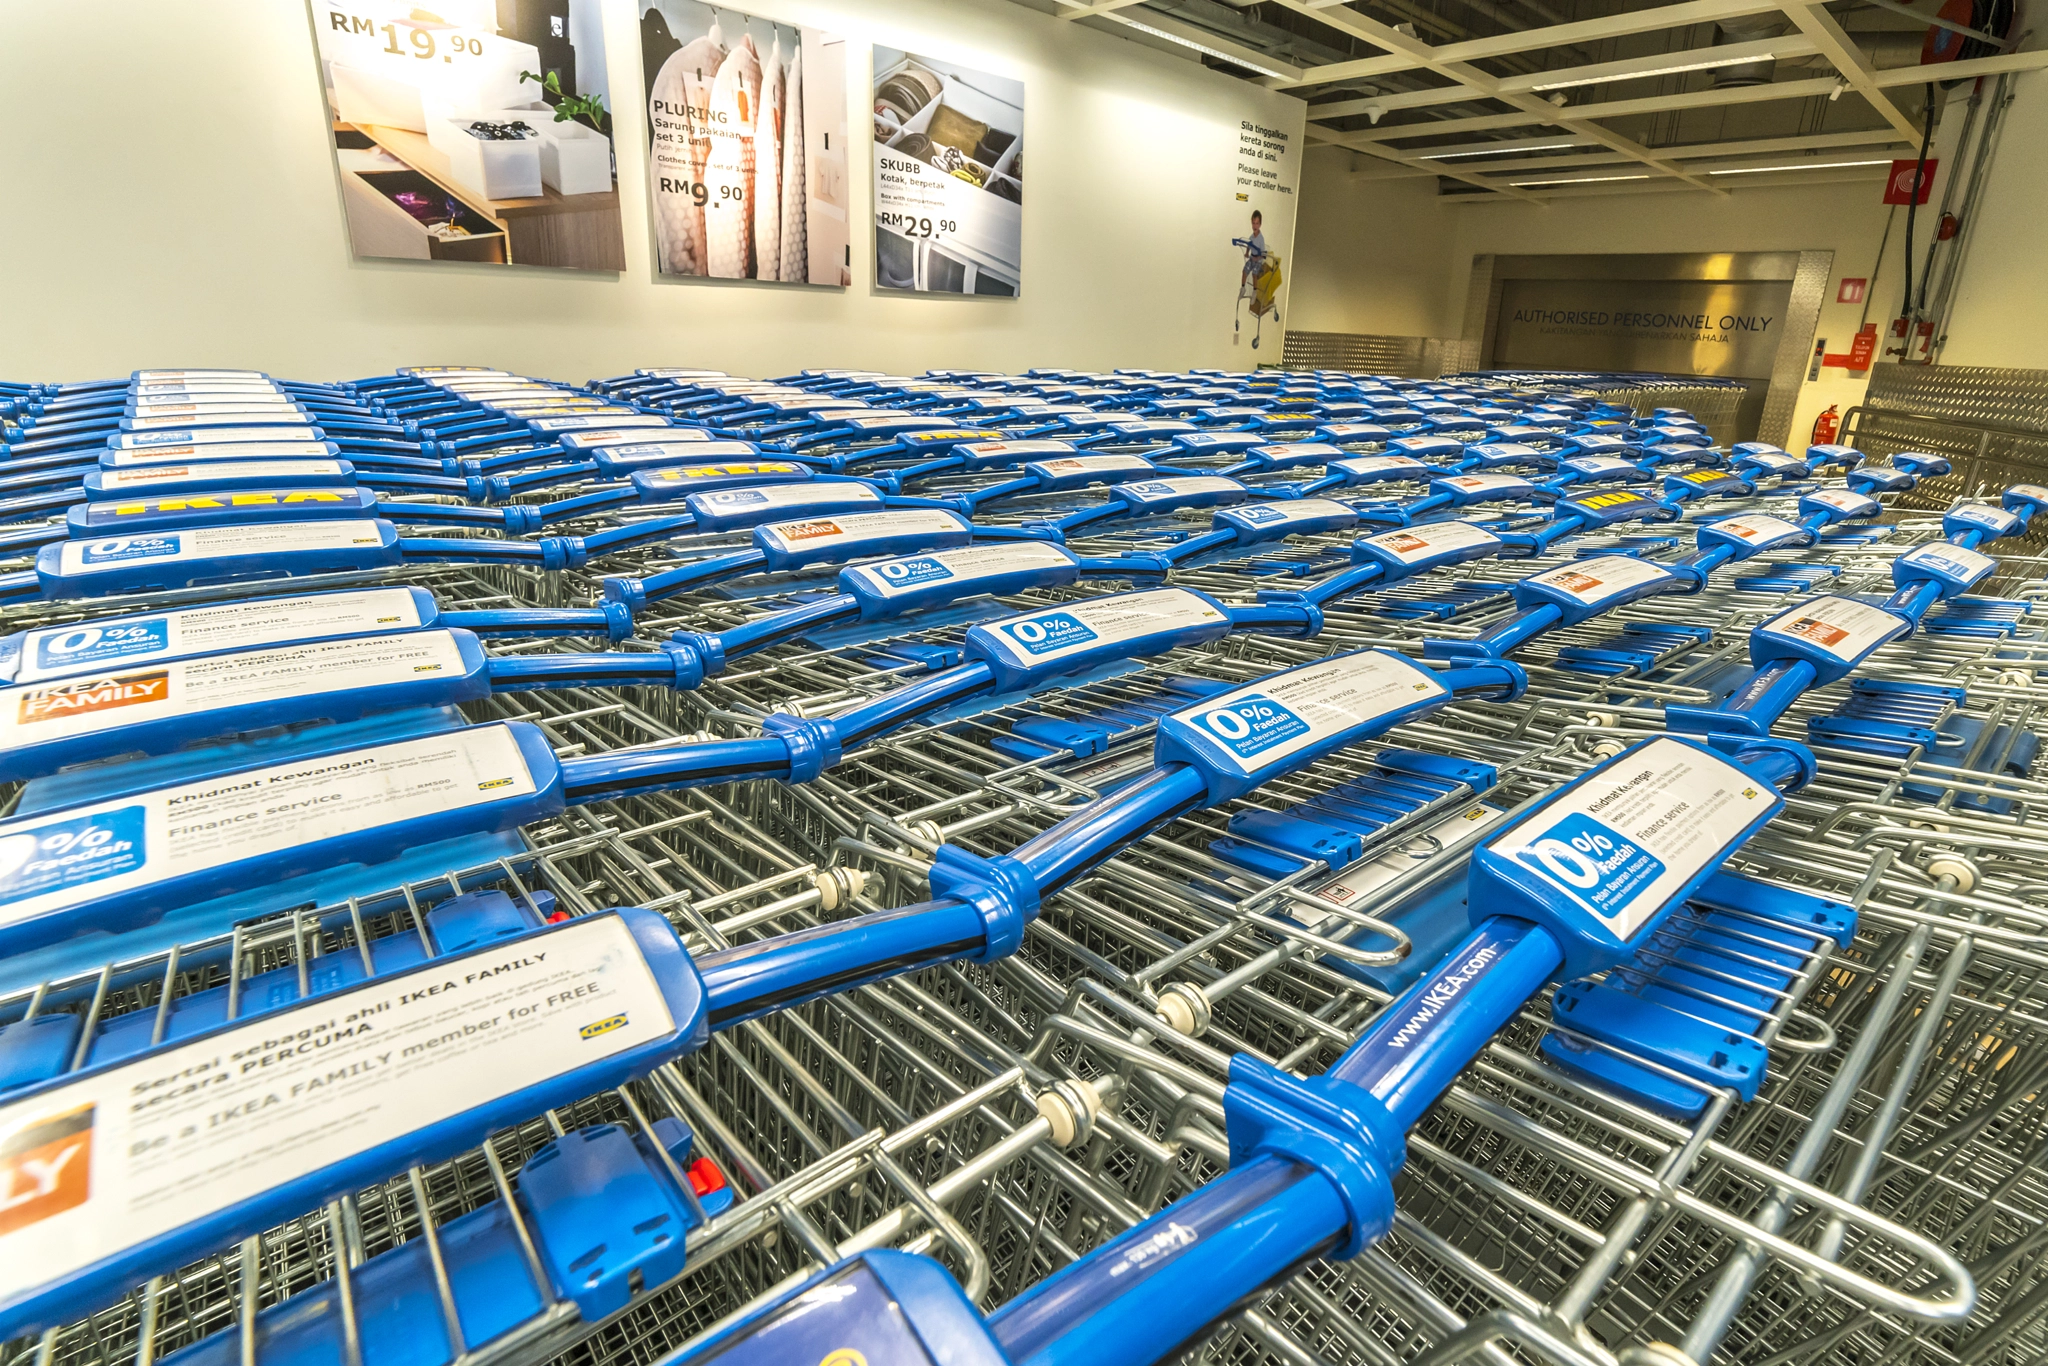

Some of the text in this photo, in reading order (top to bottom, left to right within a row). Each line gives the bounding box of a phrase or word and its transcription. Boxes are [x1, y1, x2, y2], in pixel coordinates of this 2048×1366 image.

[330, 11, 483, 63] RM19.90
[654, 100, 728, 124] PLURING
[655, 118, 695, 134] Sarung
[1241, 120, 1289, 141] Sila tinggalkan
[656, 132, 674, 142] set
[678, 134, 684, 144] 3
[1240, 133, 1285, 154] kereta sorong
[657, 154, 687, 165] Clothes
[1239, 145, 1278, 162] anda di sini.
[880, 158, 921, 174] SKUBB
[1238, 163, 1278, 180] Please leave
[660, 177, 743, 209] RM9.90
[880, 173, 945, 190] Kotak, berpetak
[1236, 176, 1293, 194] your stroller here.
[881, 212, 957, 239] RM29.90
[1513, 309, 1773, 332] AUTHORISED PERSONNEL ONLY
[1689, 332, 1729, 343] SAHAJA
[659, 463, 793, 480] IKEA
[116, 491, 344, 516] IKEA
[1576, 491, 1645, 510] IKEA
[784, 525, 836, 539] FAMILY
[91, 538, 165, 555] 0%
[882, 561, 932, 578] 0%
[911, 566, 943, 576] Faedah
[180, 607, 240, 619] Khidmat
[243, 600, 313, 611] Kewangan
[1092, 614, 1123, 627] Finance
[181, 617, 290, 635] Finance service
[1013, 619, 1071, 643] 0%
[1049, 625, 1084, 638] Faedah
[47, 627, 148, 654] 0%
[95, 634, 160, 649] Faedah
[320, 644, 353, 652] IKEA
[356, 638, 405, 648] FAMILY
[185, 654, 307, 675] secara PERCUMA
[185, 680, 204, 688] Be
[222, 672, 259, 682] IKEA
[262, 664, 315, 676] FAMILY
[319, 656, 373, 669] member
[376, 654, 396, 662] for
[399, 650, 430, 659] FREE
[24, 678, 121, 702] IKEA
[1267, 680, 1302, 695] Khidmat
[1302, 668, 1342, 683] Kewangan
[25, 681, 163, 715] FAMILY
[1297, 698, 1326, 713] Finace
[1327, 688, 1358, 704] service
[1206, 705, 1273, 739] 0%
[1252, 712, 1291, 732] Faedah
[1236, 720, 1300, 749] Pelan Bayaran Ansuran
[168, 758, 375, 806] Khidmat Kewangan
[417, 778, 451, 789] RM500
[1586, 790, 1619, 814] Khidmat
[168, 812, 258, 838] Finance
[265, 793, 343, 815] service
[1636, 801, 1690, 842] Finance service
[23, 841, 132, 875] Faedah
[1534, 831, 1614, 889] 0%
[1597, 843, 1637, 875] Faedah
[1591, 855, 1650, 904] Pelan Bayaran Ansuran
[1387, 947, 1497, 1048] www.IKEA.com
[130, 952, 547, 1097] Sertai sebagai ahli IKEA FAMILY
[129, 1071, 230, 1114] secara
[240, 1022, 373, 1075] PERCUMA
[178, 1124, 198, 1140] a
[207, 1093, 281, 1129] IKEA
[290, 1051, 393, 1098] FAMILY
[401, 1014, 502, 1059] member
[506, 1002, 541, 1022] for
[546, 981, 600, 1007] FREE
